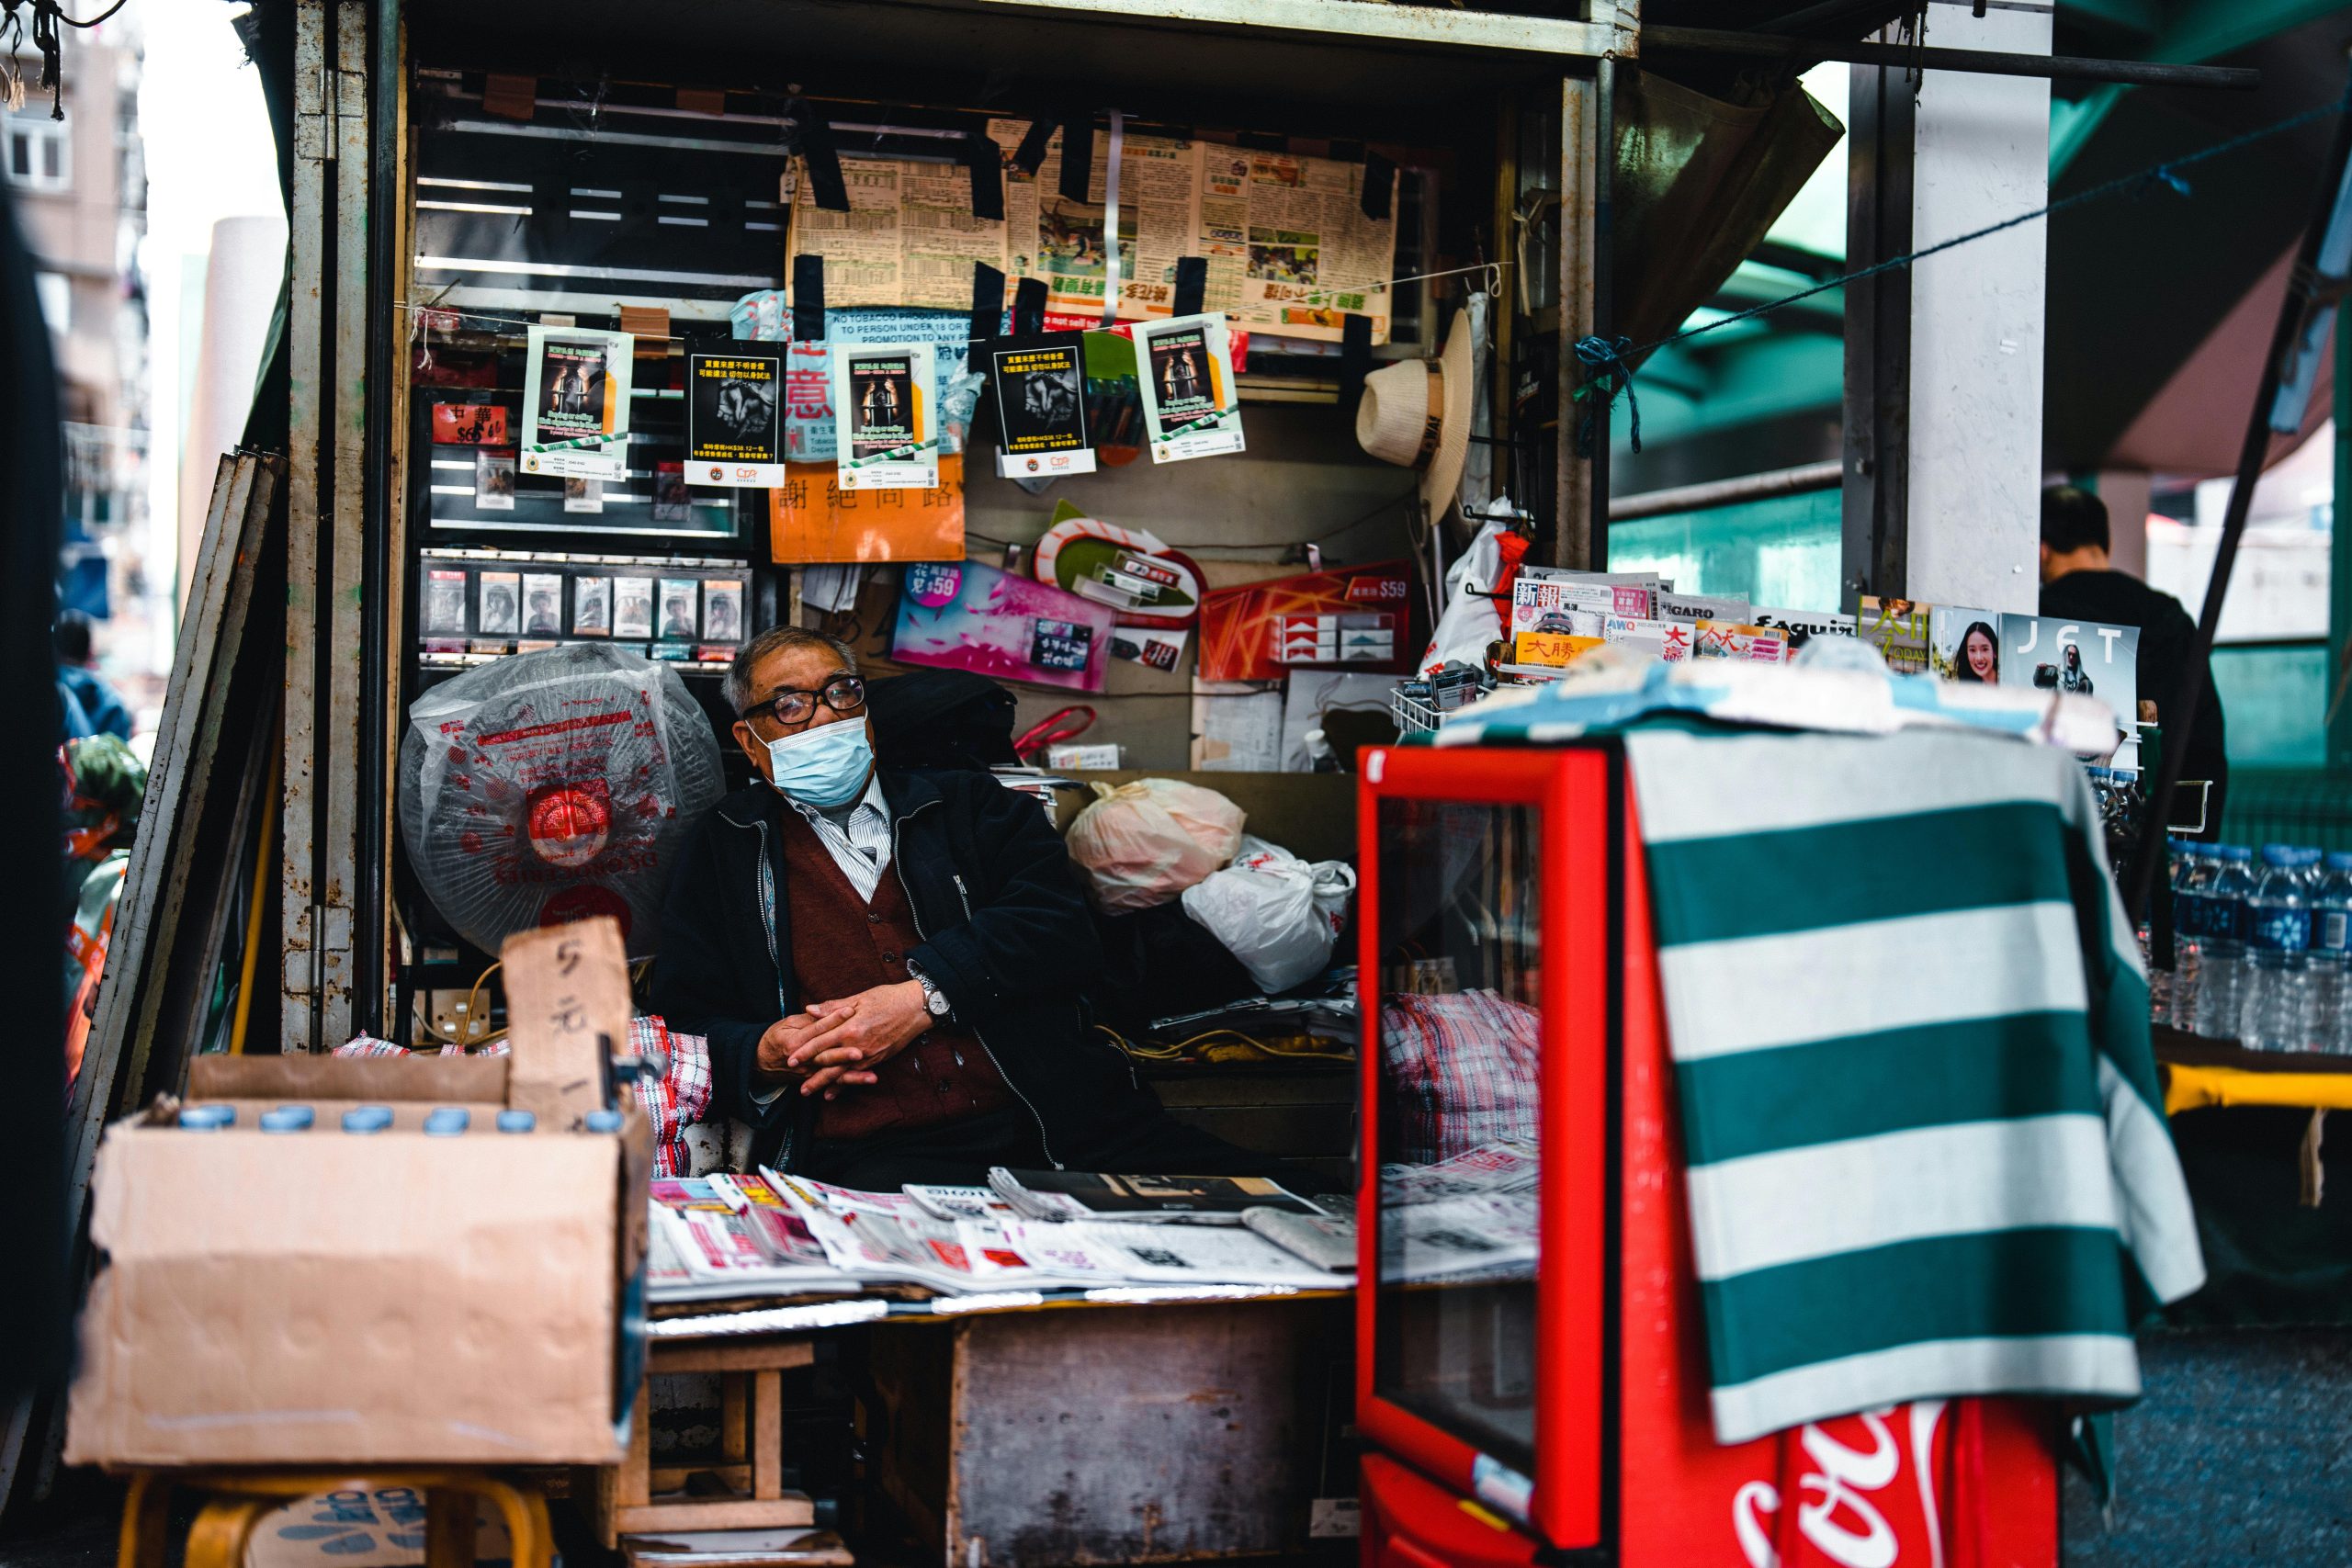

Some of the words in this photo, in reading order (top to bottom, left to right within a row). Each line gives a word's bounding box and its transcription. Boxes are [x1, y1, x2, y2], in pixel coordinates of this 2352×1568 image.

[851, 312, 896, 322] TOBACCO
[899, 311, 944, 321] PRODUCT
[842, 326, 854, 334] TO
[857, 323, 898, 333] PERSON
[900, 322, 932, 332] UNDER
[935, 322, 945, 332] 18
[948, 322, 963, 332] OR
[862, 334, 919, 344] PROMOTION
[922, 333, 934, 342] TO
[937, 333, 956, 342] ANY
[451, 405, 492, 424] 中華
[926, 577, 955, 597] $59
[1380, 581, 1407, 598] $59
[1517, 582, 1559, 607] 新報
[1607, 619, 1635, 631] AWQ
[1754, 615, 1858, 649] Esquir
[1523, 639, 1576, 660] 大勝
